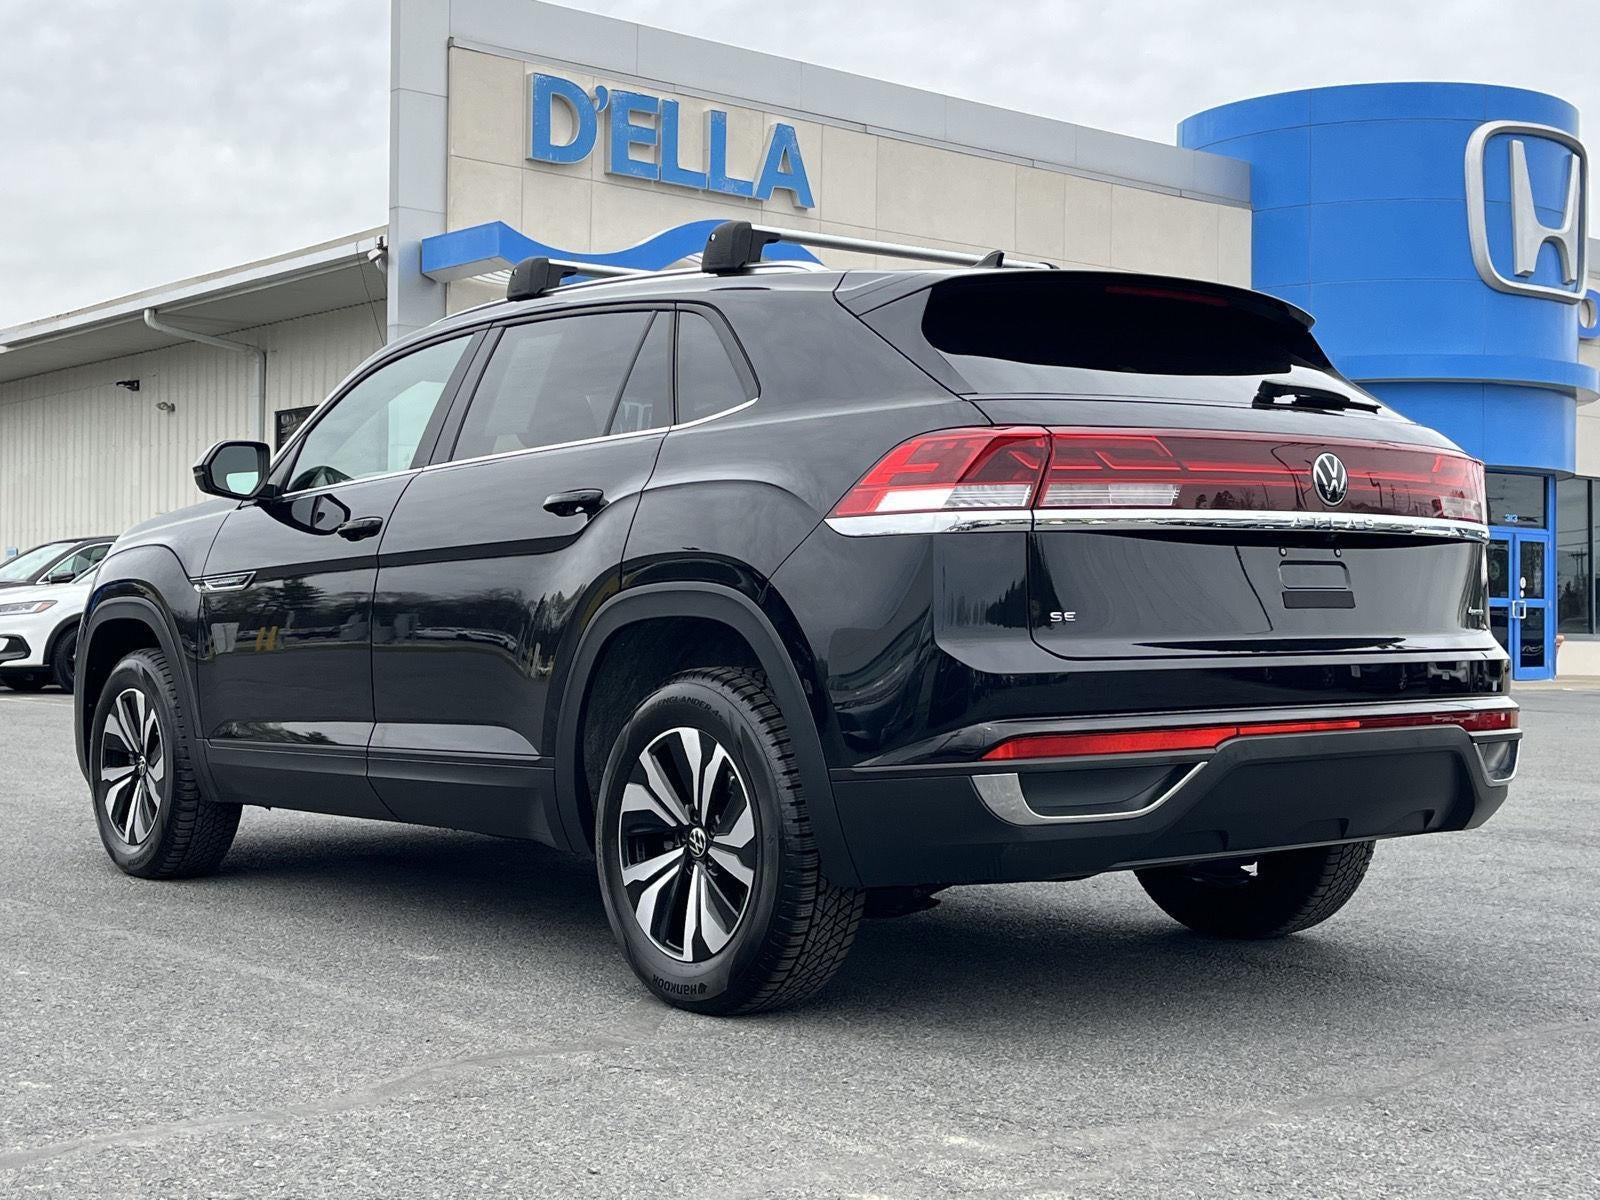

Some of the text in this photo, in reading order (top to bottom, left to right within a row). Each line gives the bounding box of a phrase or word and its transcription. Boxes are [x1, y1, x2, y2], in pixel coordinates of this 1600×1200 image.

[526, 72, 816, 209] D'ELLA
[1291, 517, 1374, 529] ATLAS
[1050, 611, 1076, 622] SE
